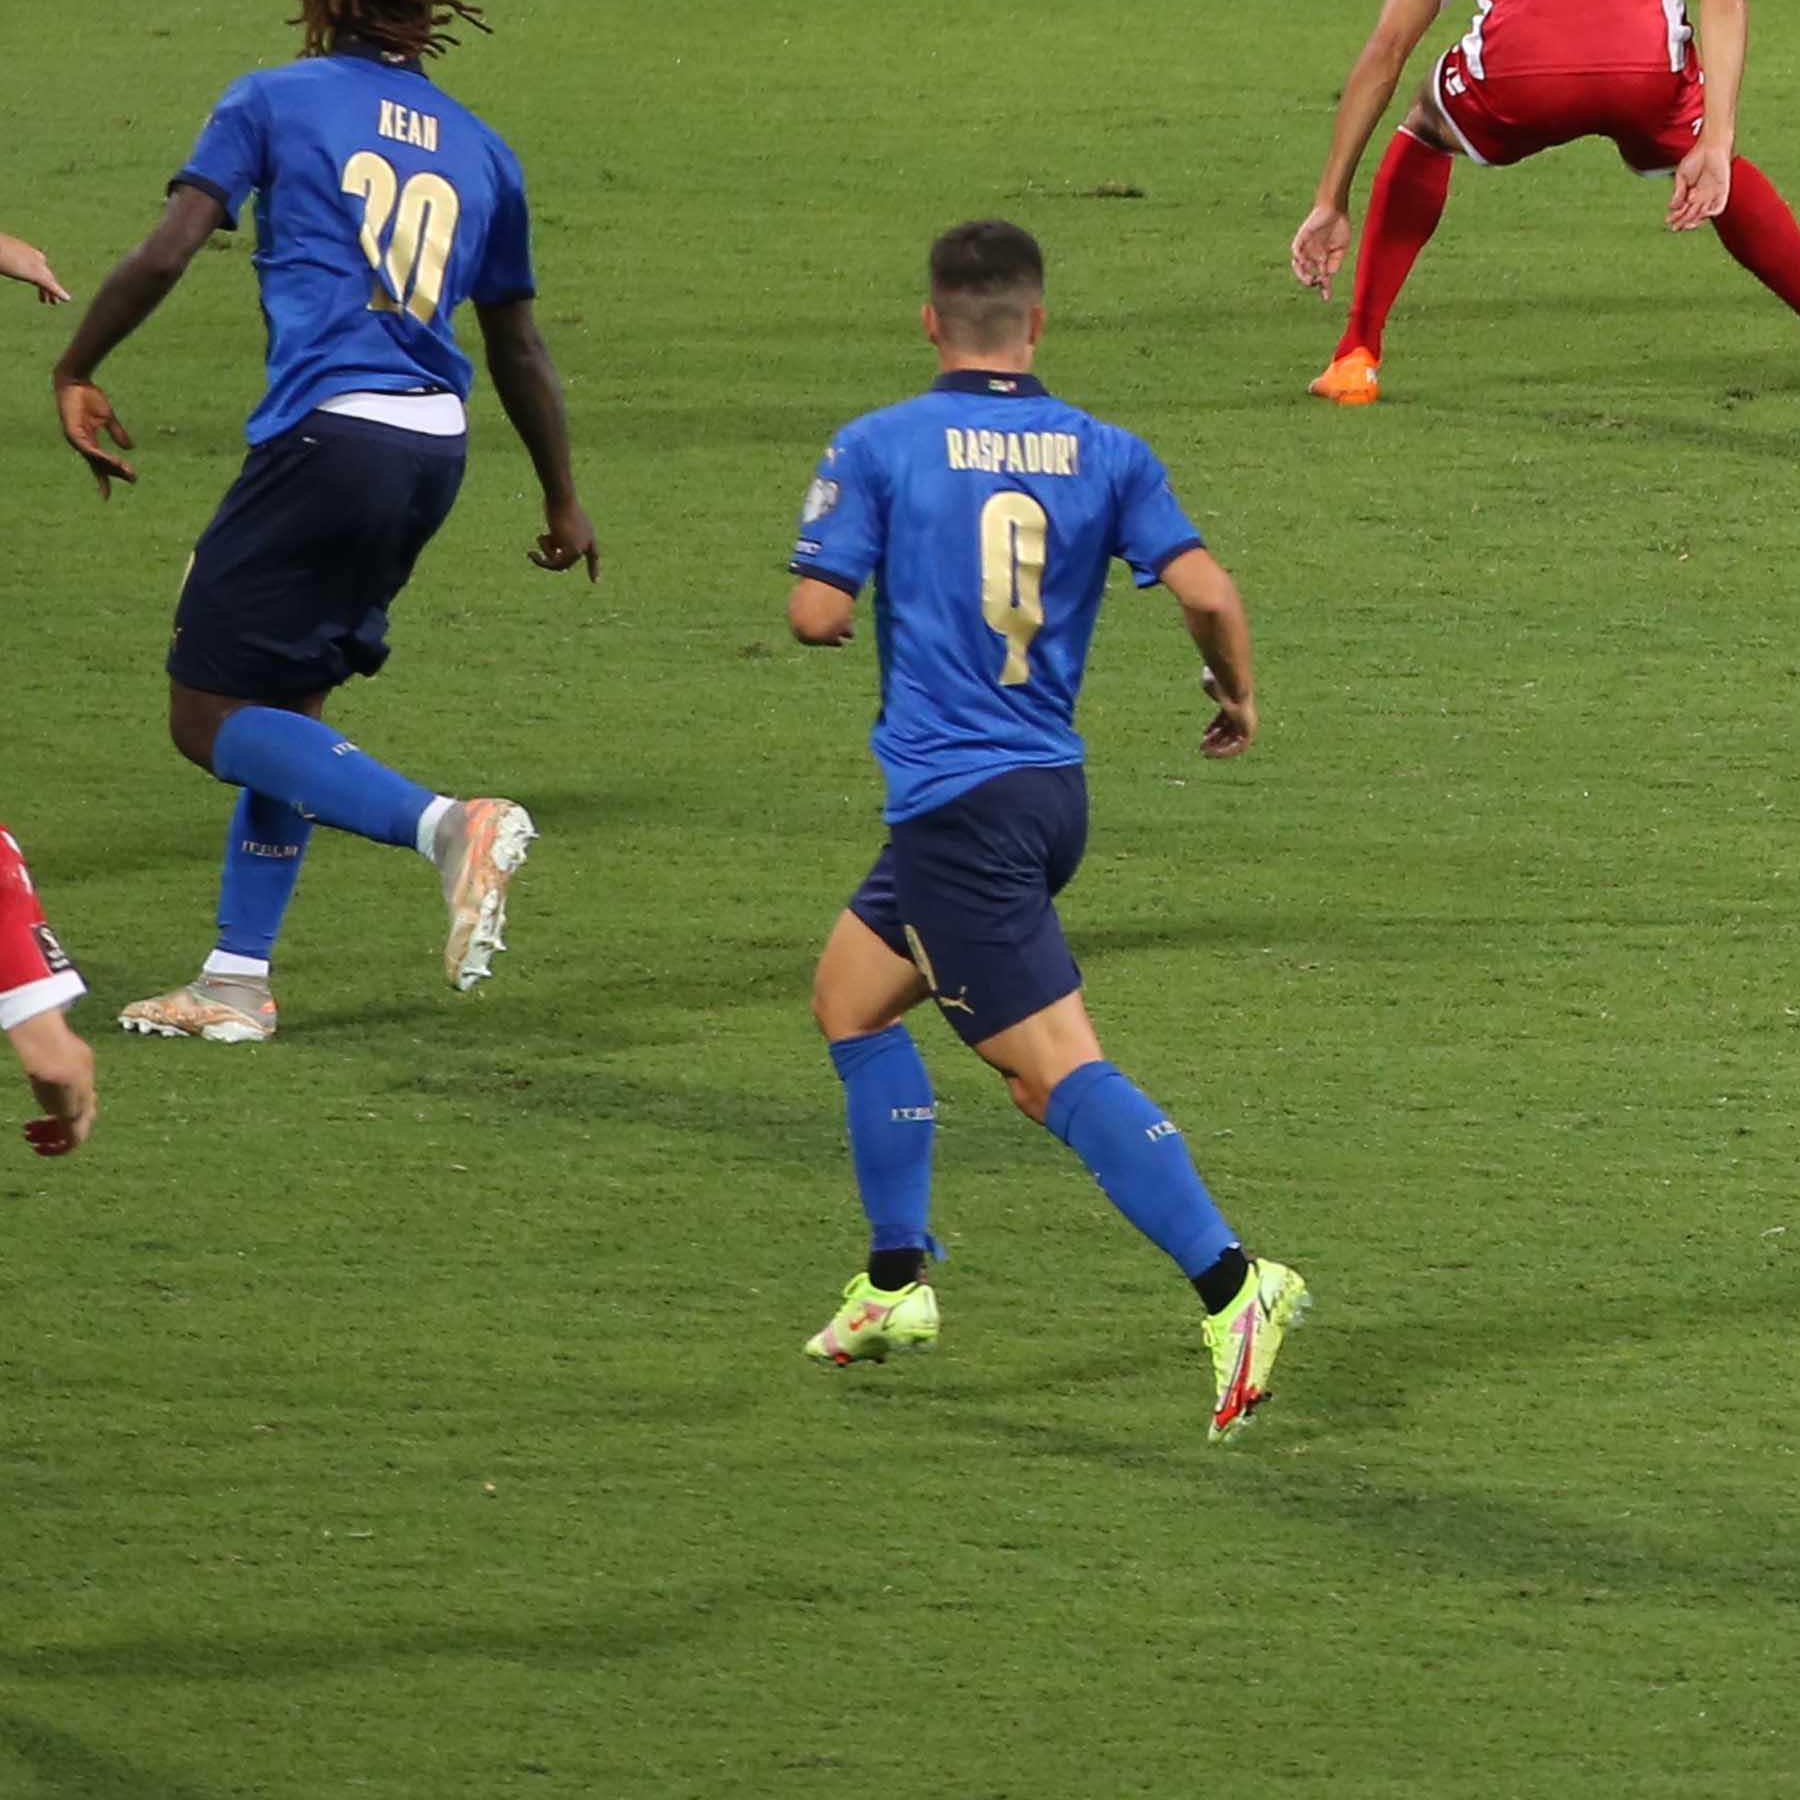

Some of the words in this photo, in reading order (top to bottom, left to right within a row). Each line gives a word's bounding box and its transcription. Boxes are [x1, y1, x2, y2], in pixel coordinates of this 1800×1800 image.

[378, 99, 438, 152] KEAN
[341, 151, 460, 324] 20
[945, 428, 1079, 476] RASPADORI
